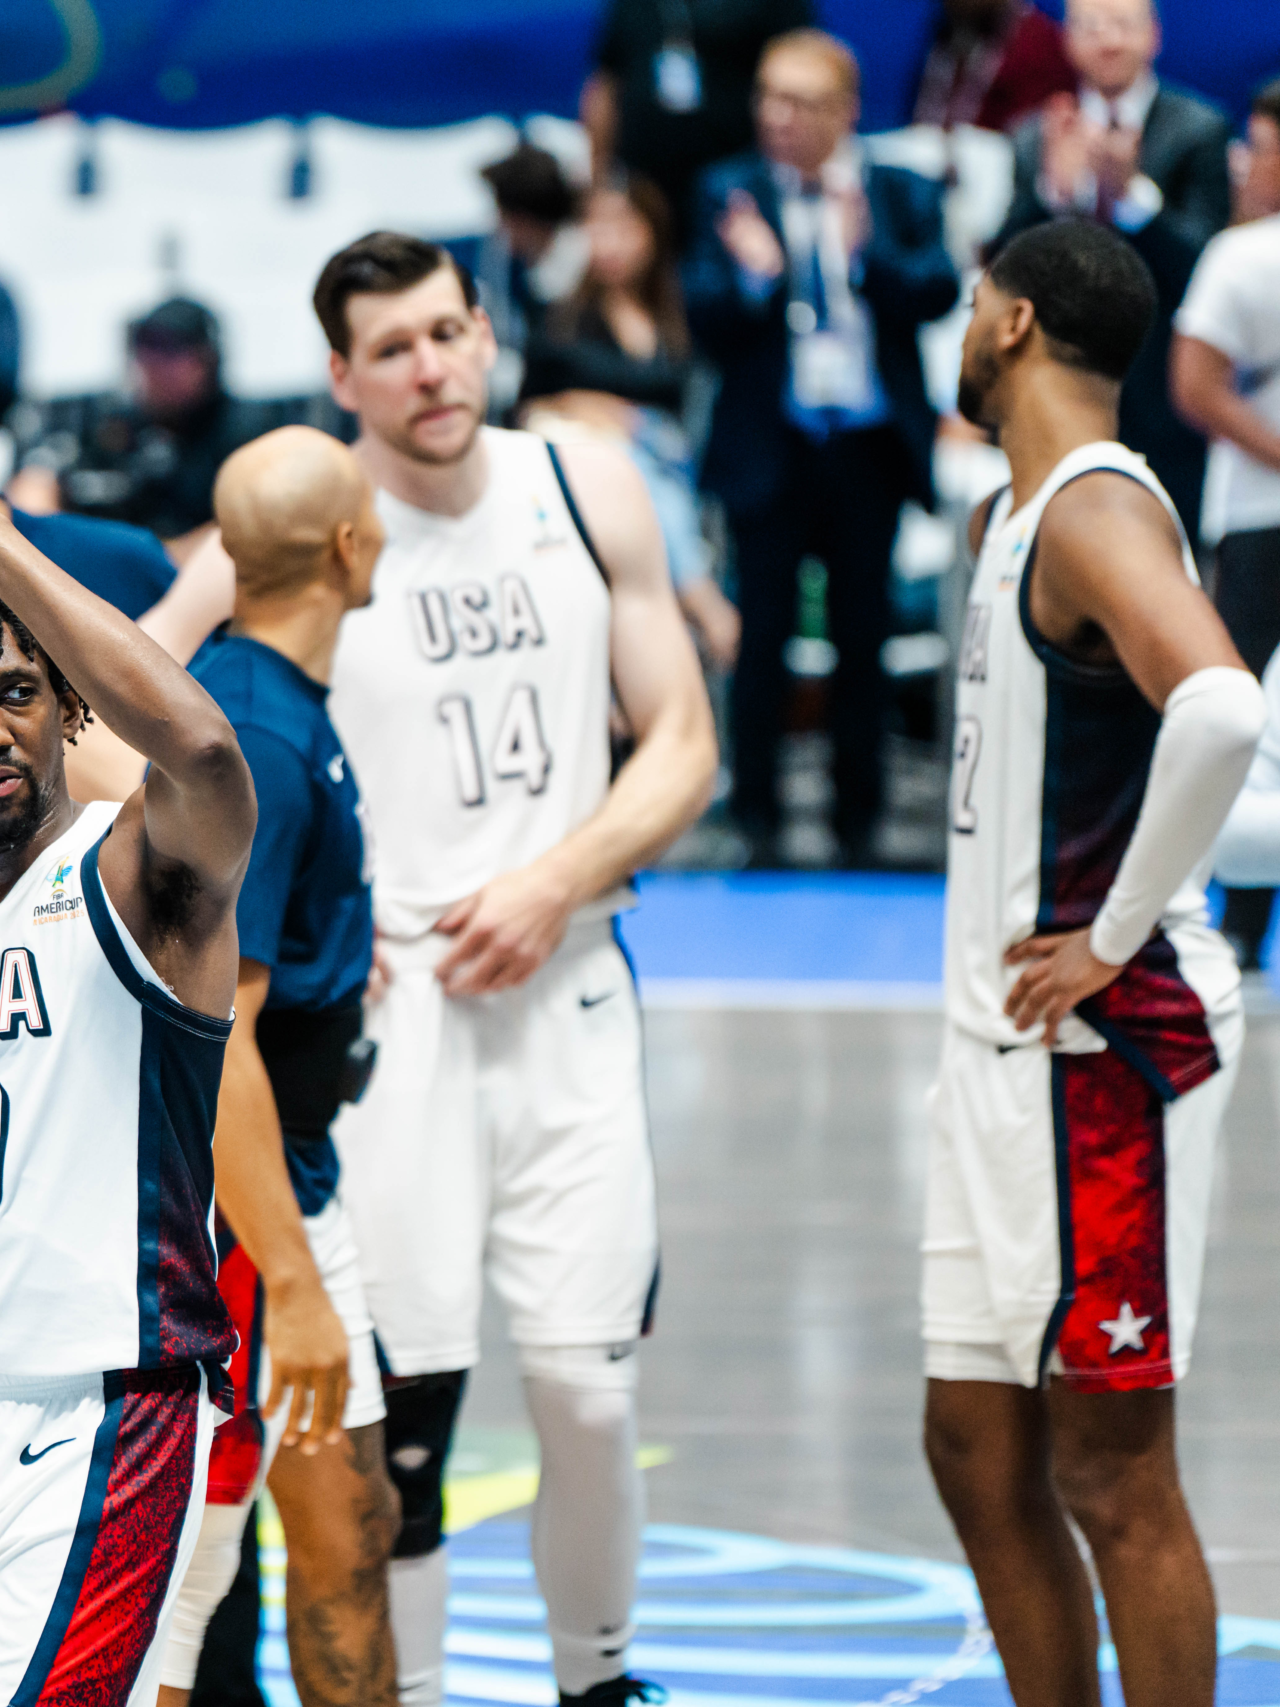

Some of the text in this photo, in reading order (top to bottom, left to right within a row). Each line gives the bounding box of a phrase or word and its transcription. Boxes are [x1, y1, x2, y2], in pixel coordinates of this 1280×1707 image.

[406, 573, 546, 664] USA
[437, 683, 553, 808] 14
[33, 896, 82, 917] AMERICUP
[33, 909, 85, 926] NICARAGUA 2025
